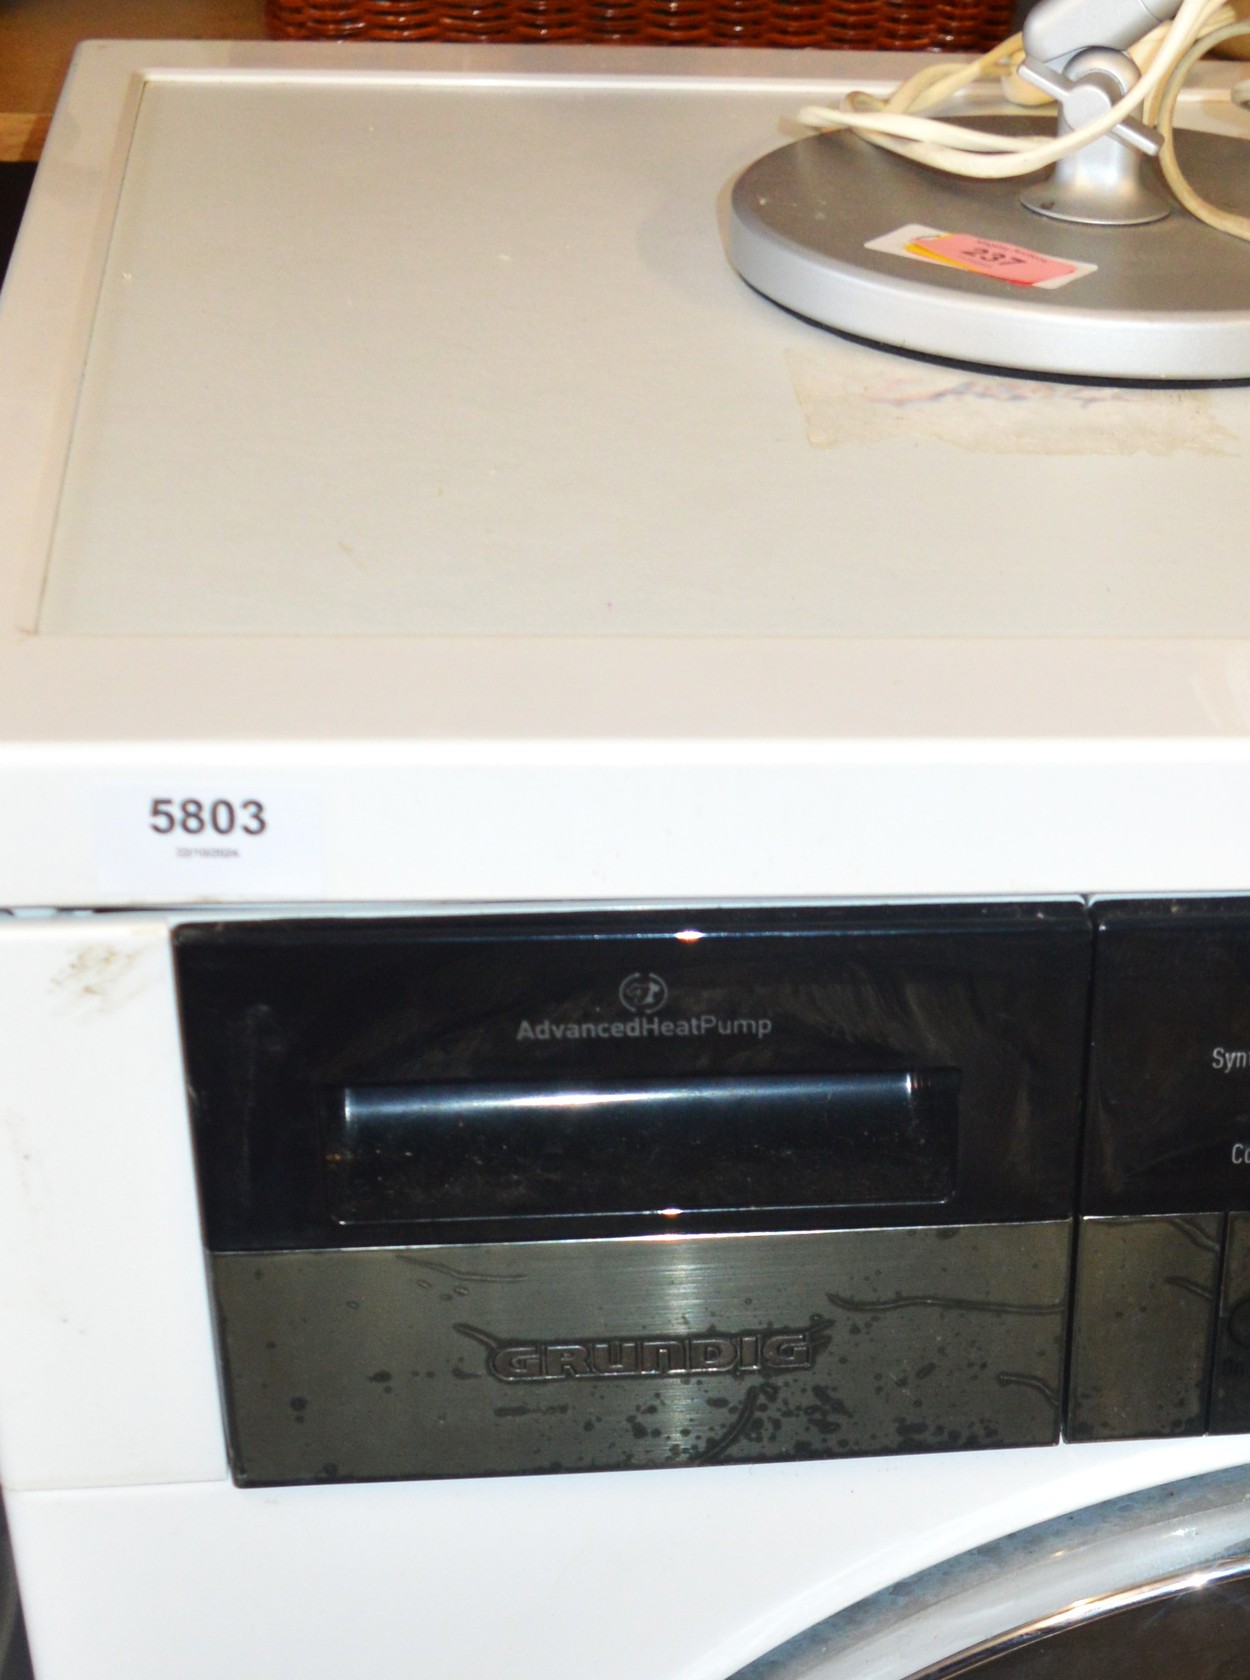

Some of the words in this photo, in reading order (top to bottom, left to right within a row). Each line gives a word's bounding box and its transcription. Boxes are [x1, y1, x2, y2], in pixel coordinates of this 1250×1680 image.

[961, 246, 1027, 267] 237
[149, 797, 268, 835] 5803
[515, 1014, 773, 1041] AdvancedHeatPump
[492, 1334, 813, 1381] GRUNDIG
